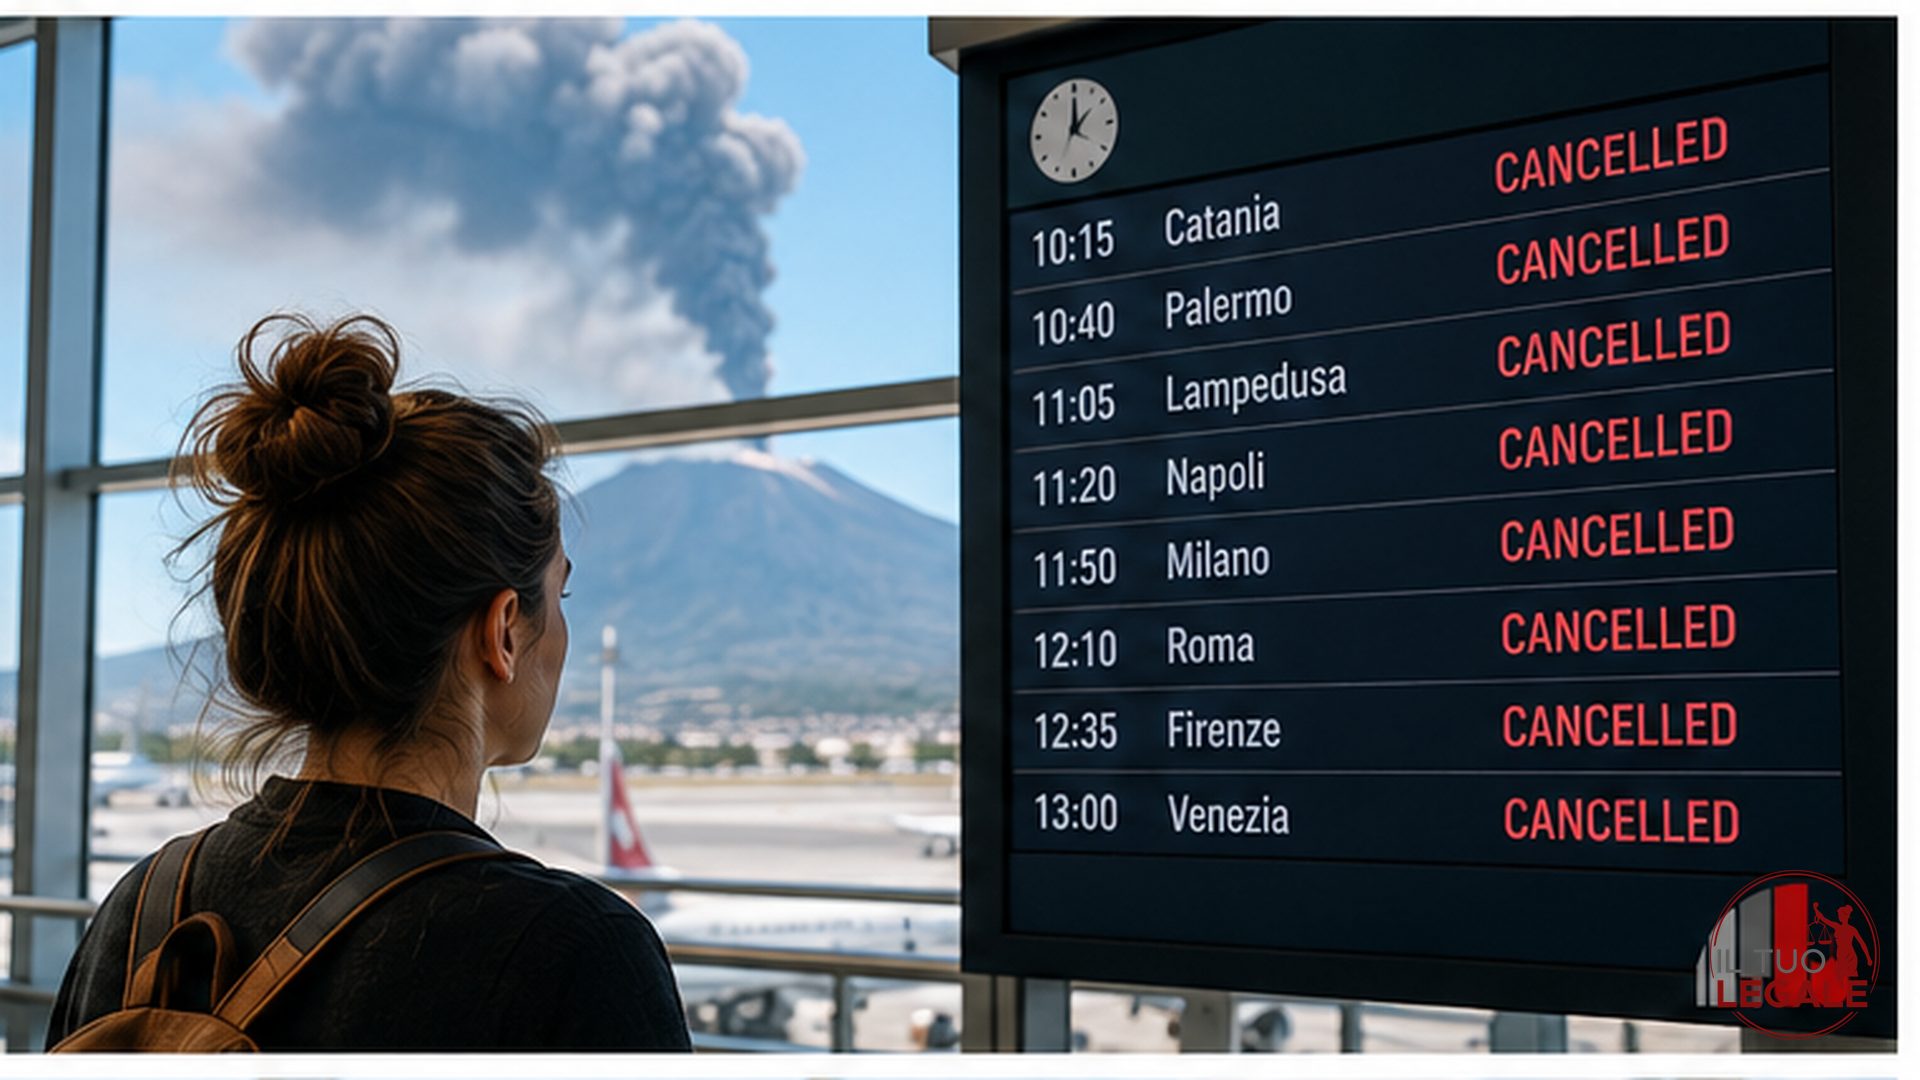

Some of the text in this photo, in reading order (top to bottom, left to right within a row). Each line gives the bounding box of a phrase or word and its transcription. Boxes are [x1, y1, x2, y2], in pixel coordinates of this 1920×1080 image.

[1033, 116, 1728, 267] 10:15 Catania CANCELLED
[1033, 213, 1729, 346] 10:40 Palermo CANCELLED
[1033, 310, 1731, 427] 11:05 Lampedusa CANCELLED
[1033, 408, 1733, 507] 11:20 Napoli CANCELLED
[1034, 506, 1734, 588] 11:50 Milano CANCELLED
[1034, 604, 1736, 669] 12:10 Roma CANCELLED
[1035, 702, 1737, 749] 12:35 Firenze CANCELLED
[1035, 793, 1739, 844] 13:00 Venezia CANCELLED
